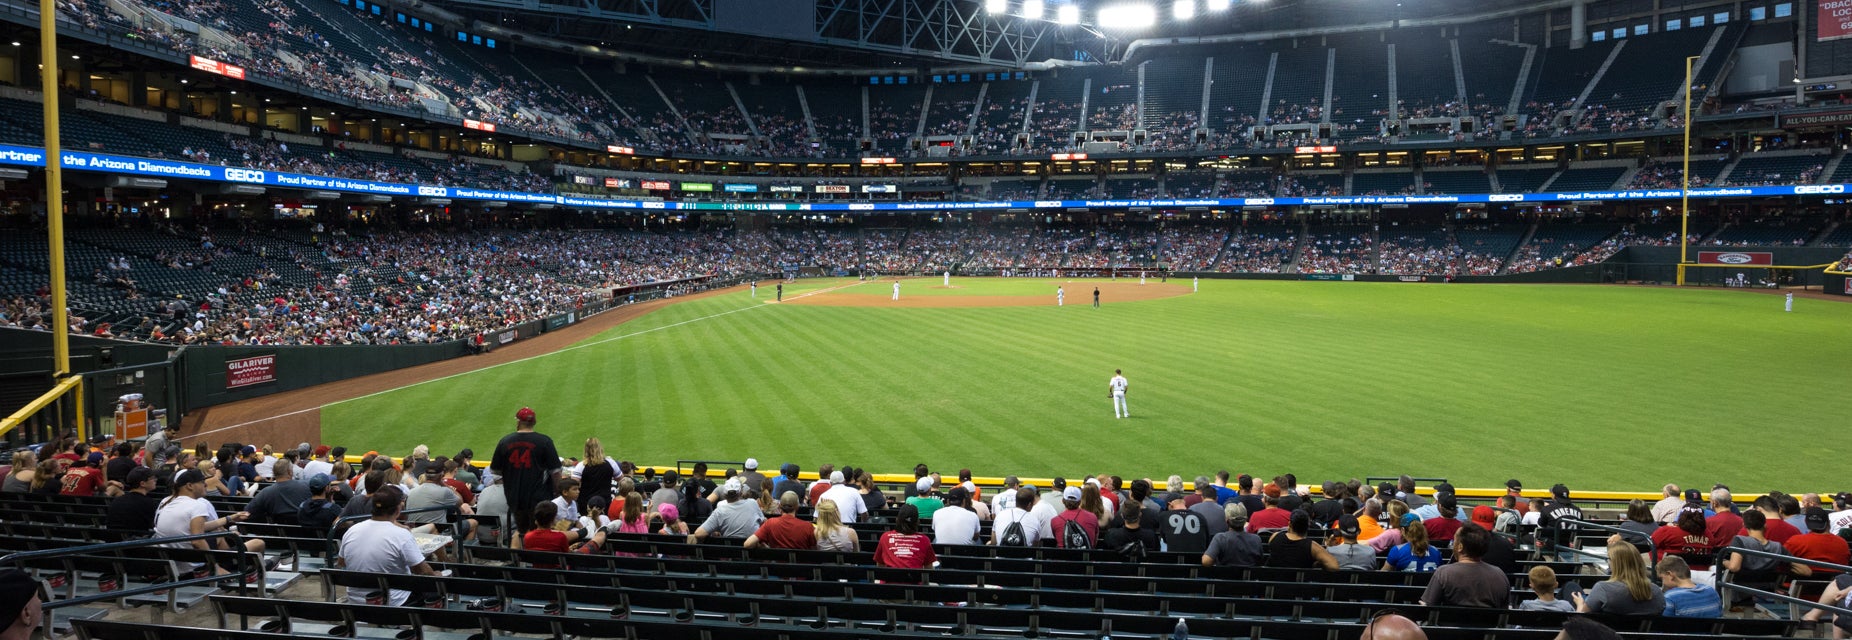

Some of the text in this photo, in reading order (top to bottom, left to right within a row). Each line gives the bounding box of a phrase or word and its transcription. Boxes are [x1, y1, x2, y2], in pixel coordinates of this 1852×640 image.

[64, 154, 87, 166] the
[90, 156, 136, 171] Arizona
[138, 161, 210, 177] Diamondbacks
[224, 168, 264, 183] GEICO
[278, 174, 410, 194] Proud Partner of the Arizona Diamondbacks
[1794, 185, 1844, 194] GEICO
[418, 186, 447, 196] GEICO
[474, 190, 494, 198] Partner
[228, 358, 273, 370] GILA RIVER
[510, 450, 532, 468] 44
[1168, 514, 1200, 534] 90
[1683, 535, 1709, 545] TOMAS
